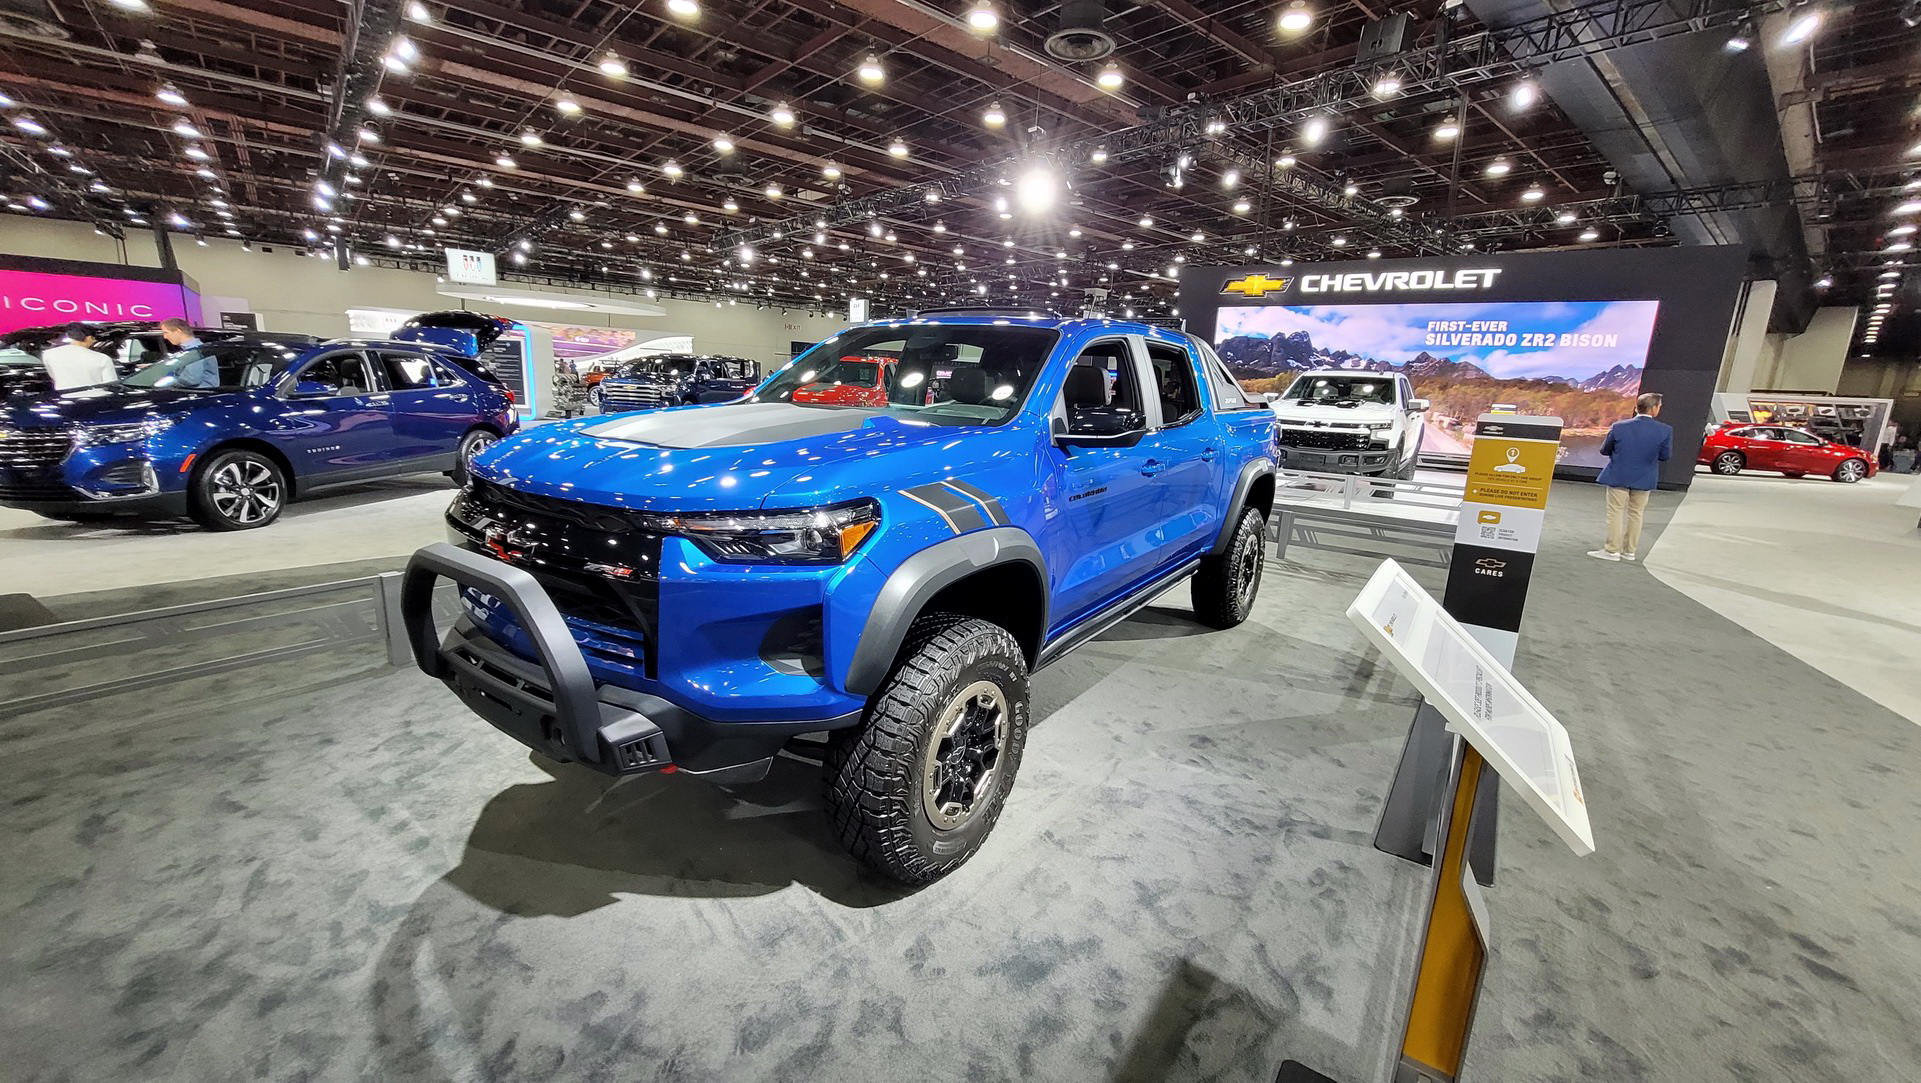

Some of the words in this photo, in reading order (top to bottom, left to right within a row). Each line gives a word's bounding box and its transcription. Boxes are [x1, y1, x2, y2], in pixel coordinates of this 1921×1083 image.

[1300, 268, 1502, 293] CHEVROLET
[3, 296, 153, 317] ICONIC
[1427, 320, 1508, 332] FIRST-EVER
[1425, 333, 1518, 347] SILVERADO
[1520, 333, 1555, 347] ZR2
[1559, 333, 1619, 348] BISON
[1475, 567, 1503, 578] CARES
